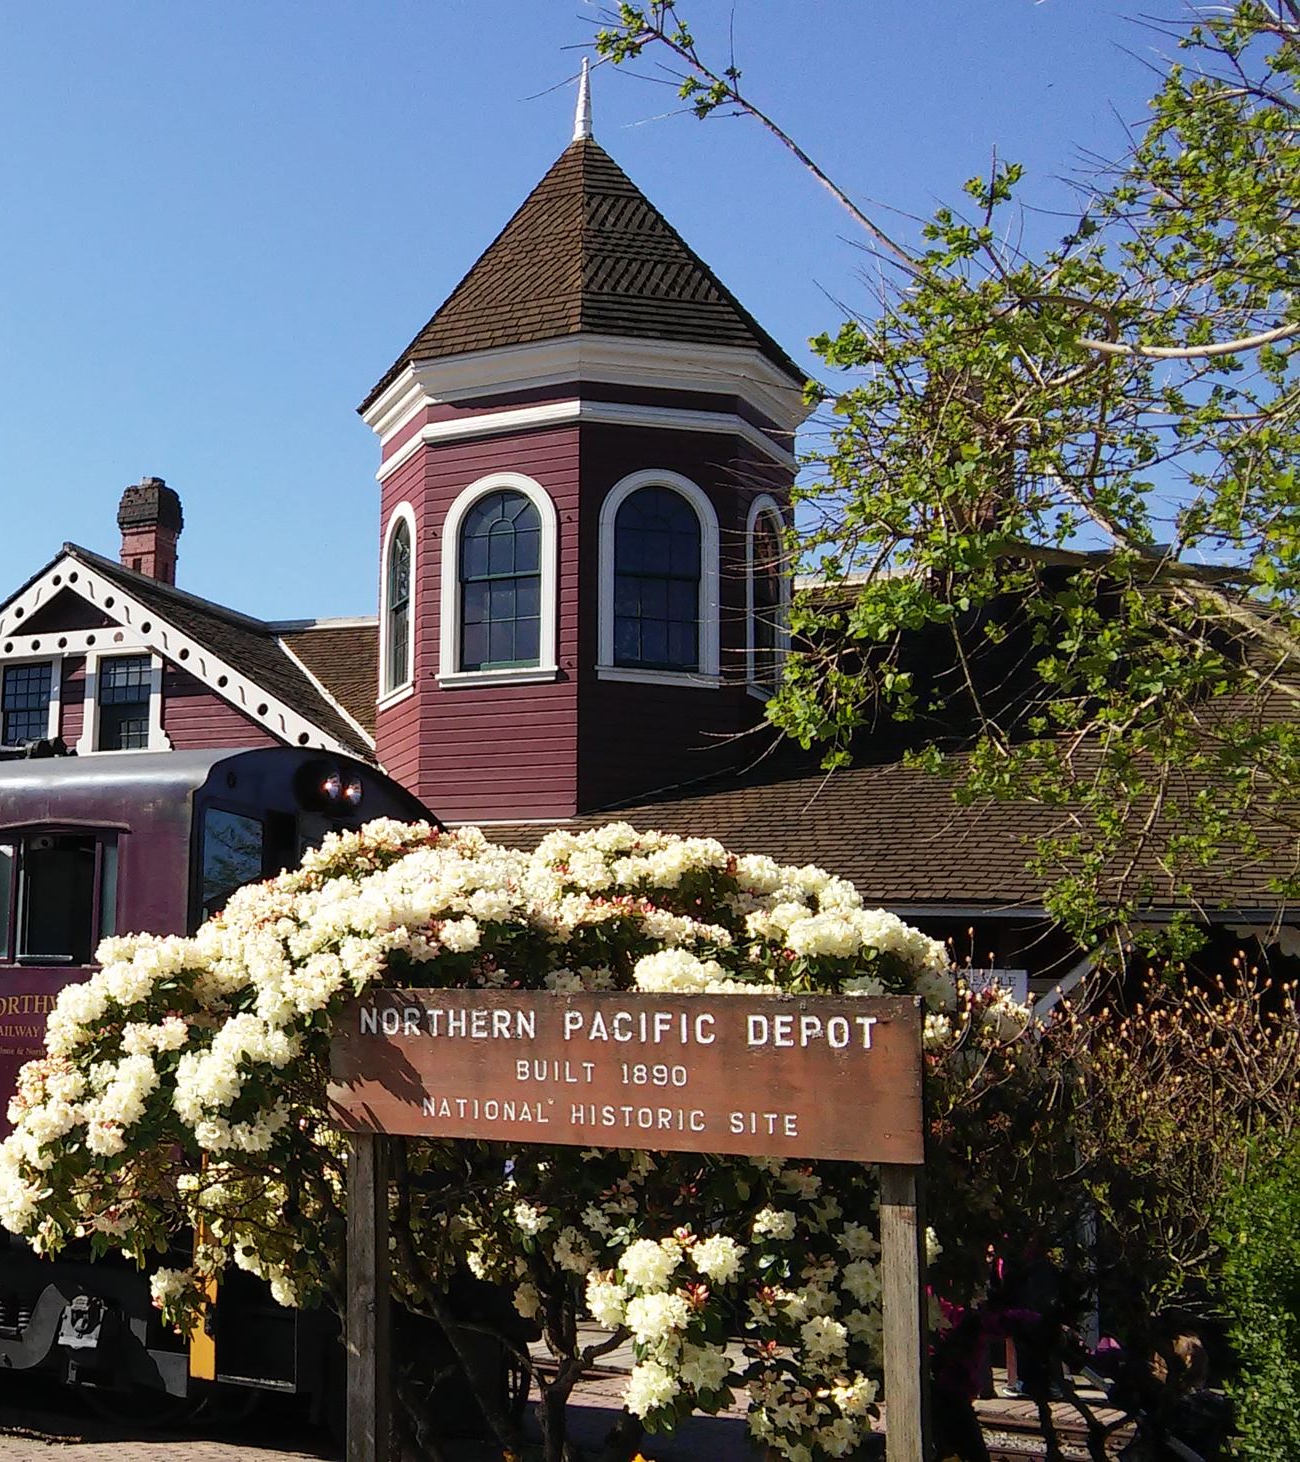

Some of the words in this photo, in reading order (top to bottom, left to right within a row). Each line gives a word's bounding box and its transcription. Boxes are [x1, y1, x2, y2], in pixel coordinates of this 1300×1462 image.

[360, 1007, 536, 1039] NORTHERN
[563, 1010, 716, 1045] PACIFIC
[747, 1014, 878, 1049] DEPOT
[515, 1059, 595, 1083] BUILT
[621, 1063, 688, 1087] 1890
[422, 1097, 549, 1123] NATIONAL
[570, 1103, 705, 1132] HISTORIC
[729, 1112, 799, 1137] SITE
